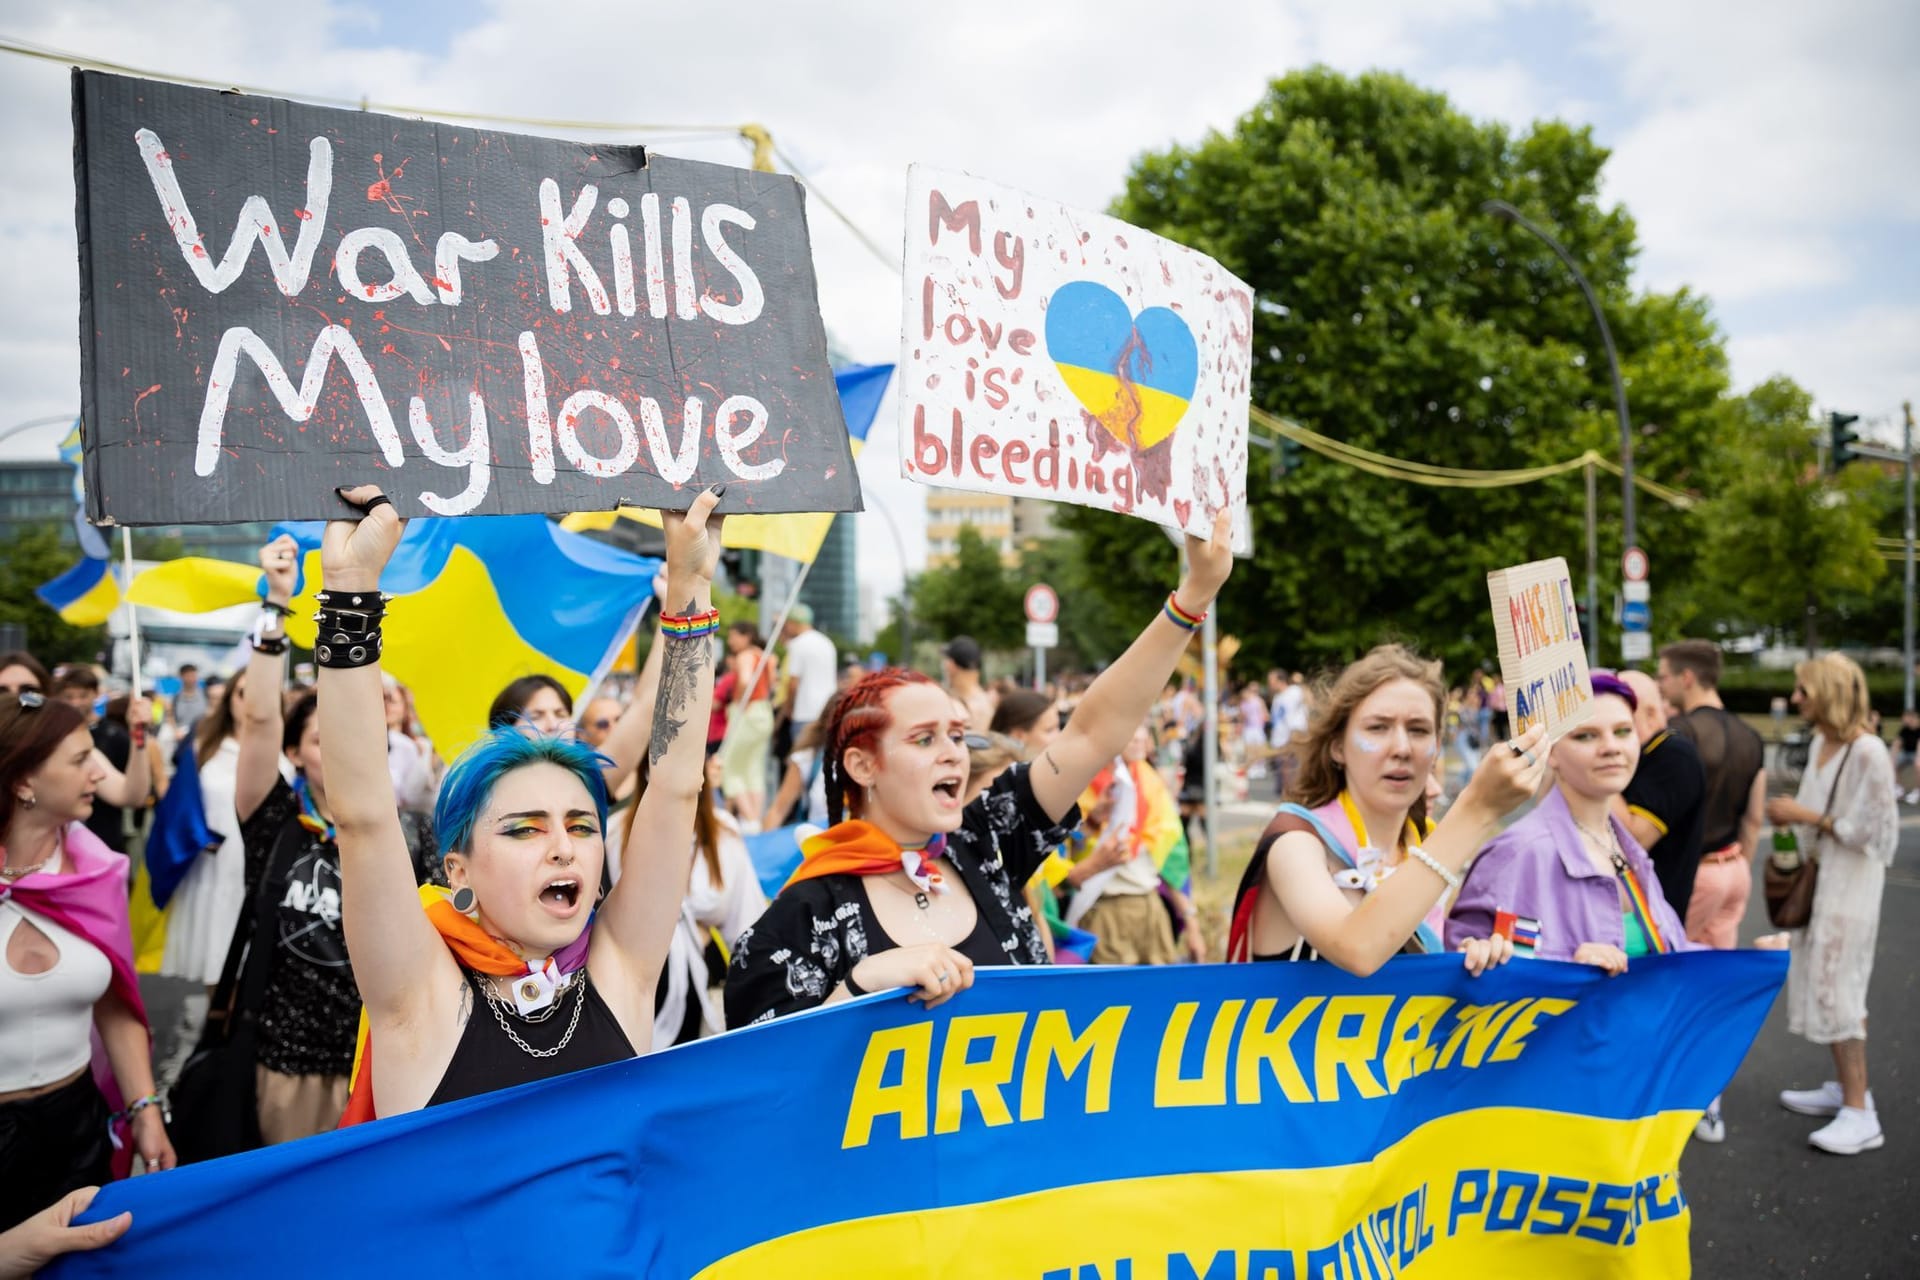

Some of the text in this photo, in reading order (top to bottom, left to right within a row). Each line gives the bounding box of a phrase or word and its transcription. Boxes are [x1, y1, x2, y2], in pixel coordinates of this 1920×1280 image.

[134, 127, 765, 325] War Kills
[929, 189, 1025, 301] My
[922, 275, 1036, 356] love
[194, 324, 787, 516] My love
[965, 357, 1010, 410] is
[913, 403, 1134, 514] bleeding
[1509, 583, 1550, 659] MAKE
[1549, 661, 1587, 721] WAR
[842, 1006, 1130, 1149] ARM
[1448, 1169, 1687, 1247] POSSL
